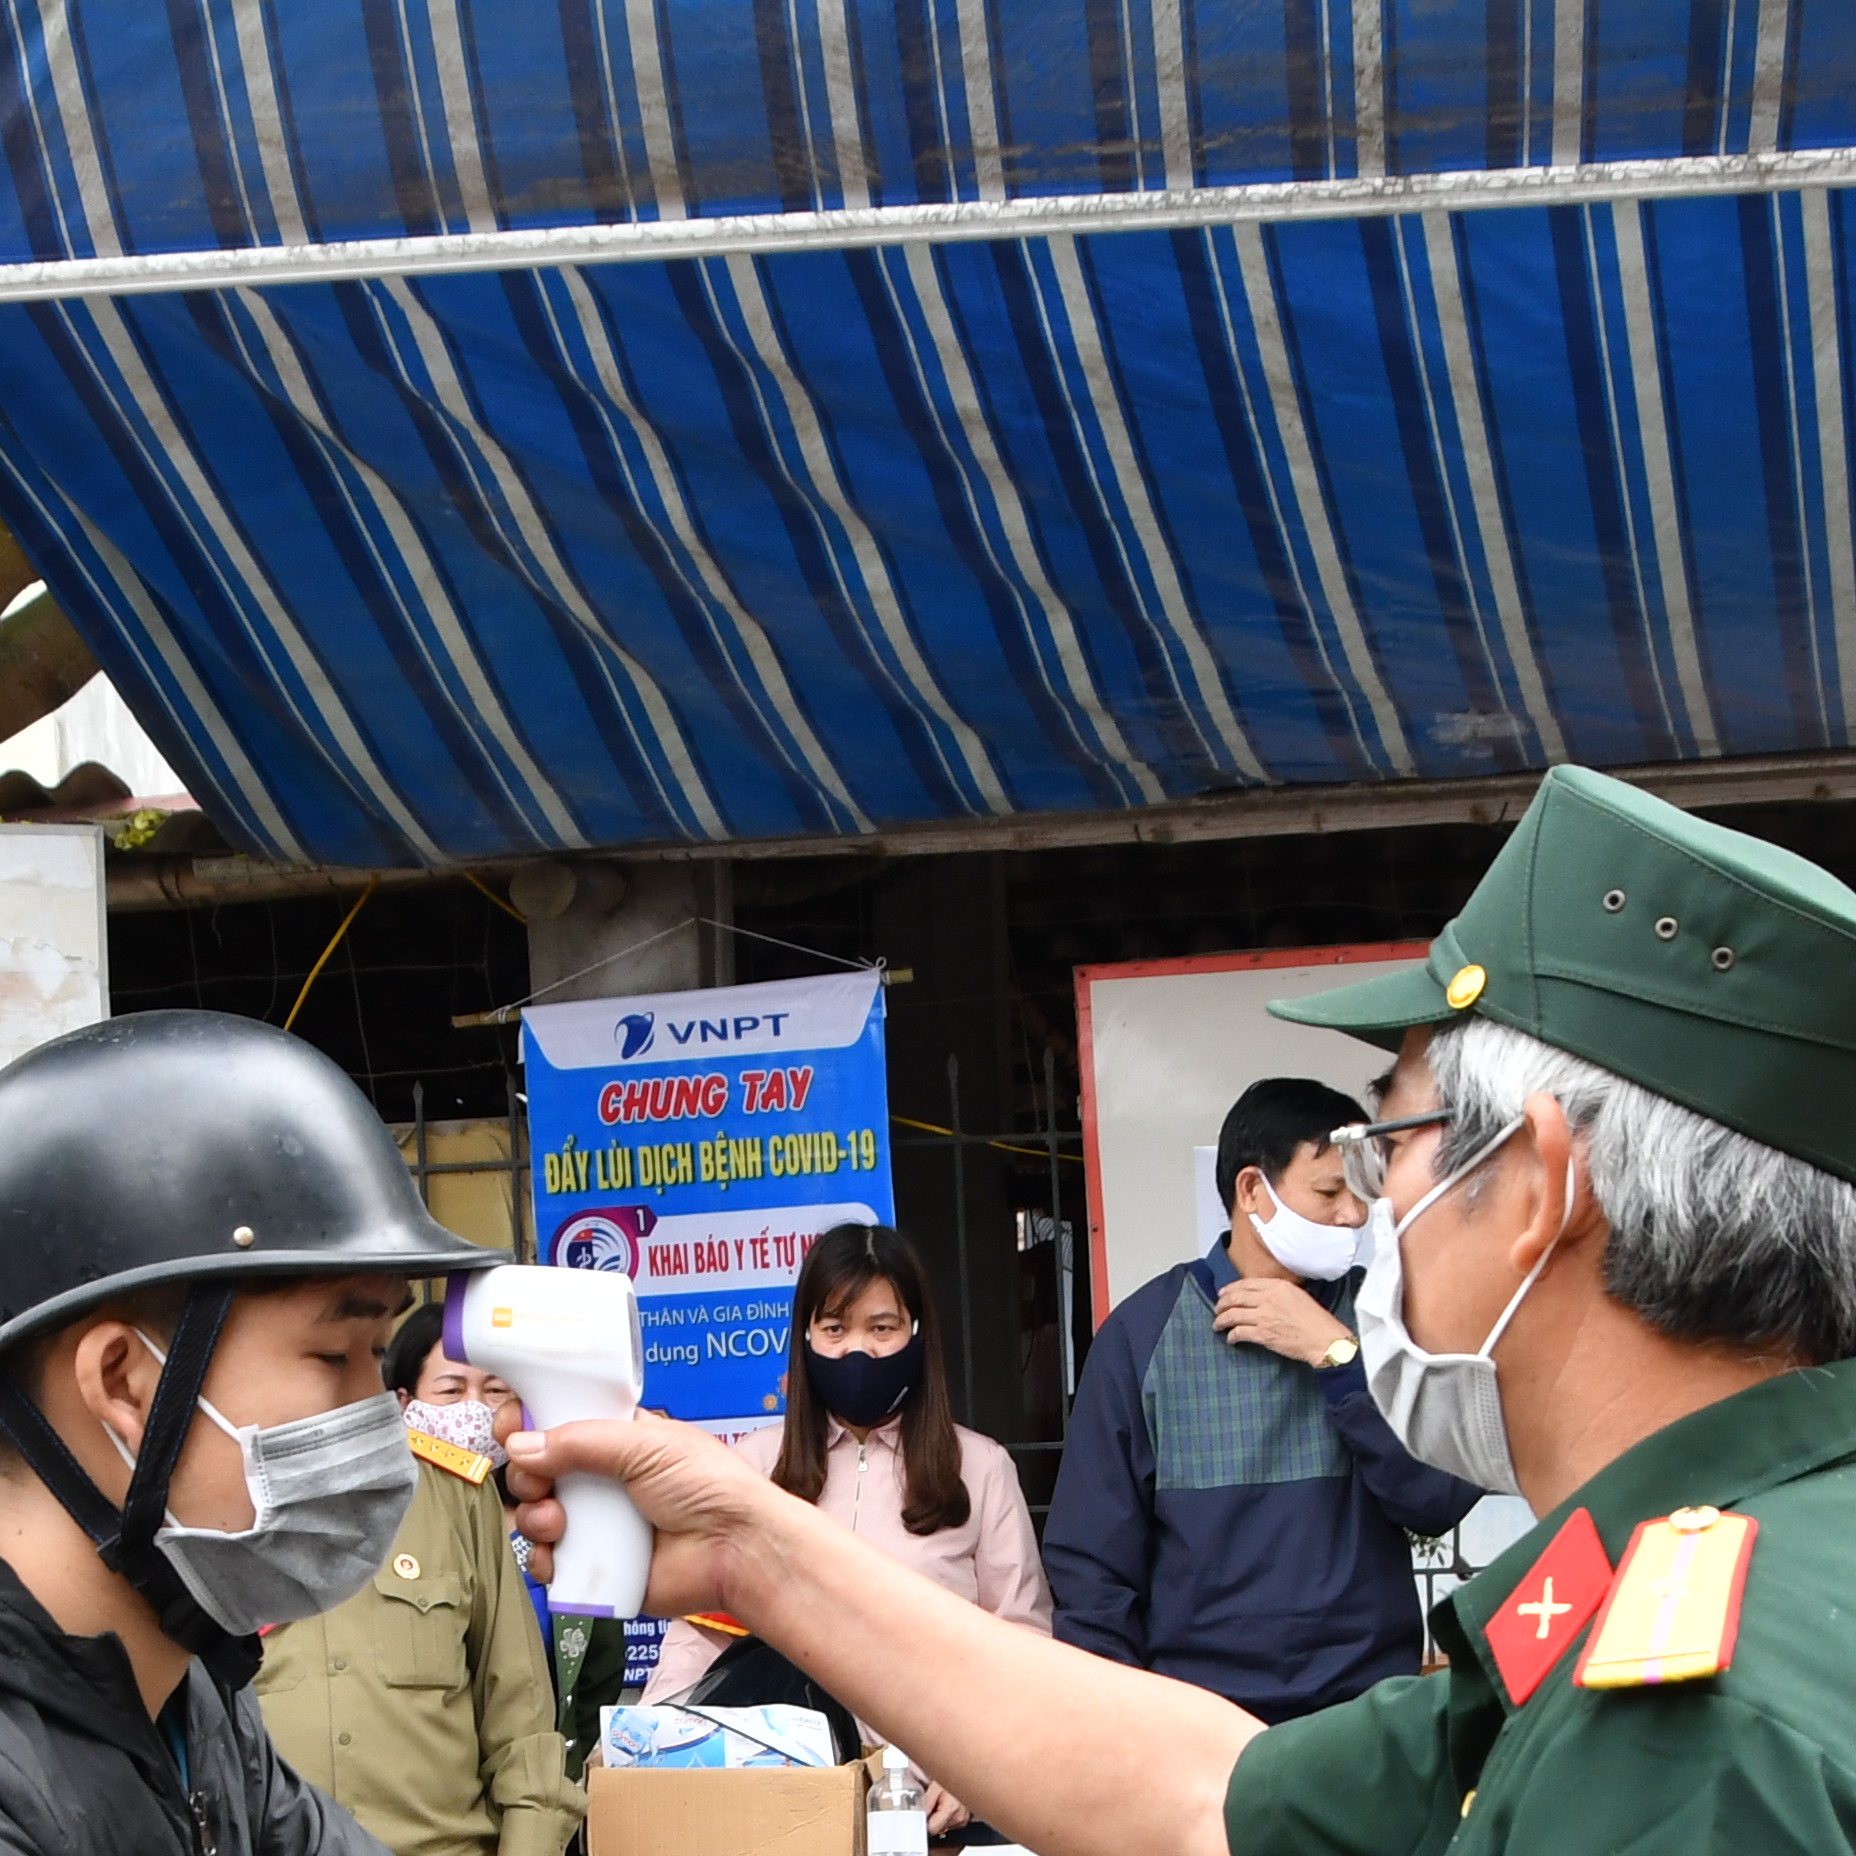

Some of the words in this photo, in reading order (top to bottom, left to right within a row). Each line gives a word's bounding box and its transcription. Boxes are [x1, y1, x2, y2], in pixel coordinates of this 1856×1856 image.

[667, 1013, 790, 1045] VNPT
[598, 1072, 729, 1126] CHUNG
[740, 1065, 814, 1114] TAY
[544, 1134, 589, 1194] ĐẨY
[596, 1139, 633, 1190] LÙI
[638, 1143, 693, 1195] DỊCH
[699, 1131, 763, 1190] BỆNH
[769, 1128, 877, 1177] COVID-19
[635, 1208, 646, 1232] 1
[648, 1243, 689, 1277] KHAI
[693, 1234, 729, 1273] BÁO
[734, 1238, 744, 1271] Y
[749, 1226, 770, 1270] TẾ
[773, 1231, 797, 1275] TỰ
[639, 1307, 684, 1327] THÂN
[687, 1304, 710, 1324] VÀ
[713, 1305, 743, 1323] GIA
[746, 1300, 790, 1321] ĐÌNH
[645, 1341, 699, 1366] dụng
[623, 1620, 655, 1637] hông
